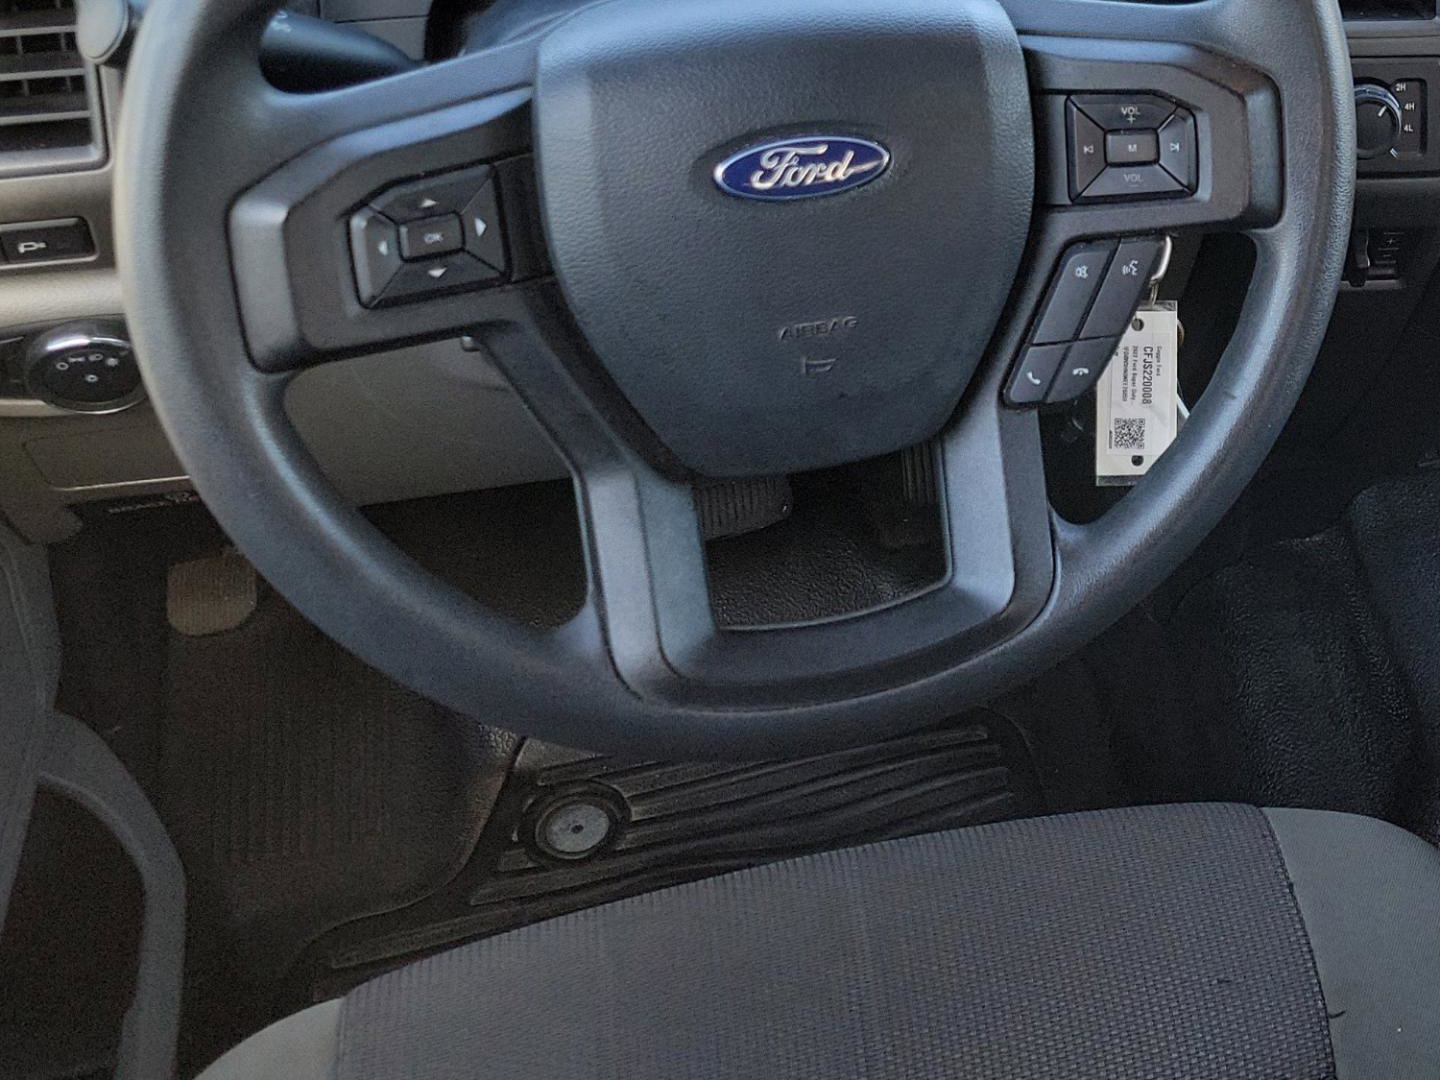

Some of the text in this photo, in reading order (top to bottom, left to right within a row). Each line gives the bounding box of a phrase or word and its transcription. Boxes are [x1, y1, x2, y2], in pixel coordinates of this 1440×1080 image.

[1395, 82, 1407, 92] 2H
[1121, 106, 1140, 115] VOL
[1404, 102, 1415, 111] 4H
[1403, 124, 1414, 132] 4L
[1128, 144, 1137, 152] M
[751, 144, 878, 191] Ford
[1123, 173, 1144, 182] VOL
[1142, 346, 1154, 405] CFJS220008
